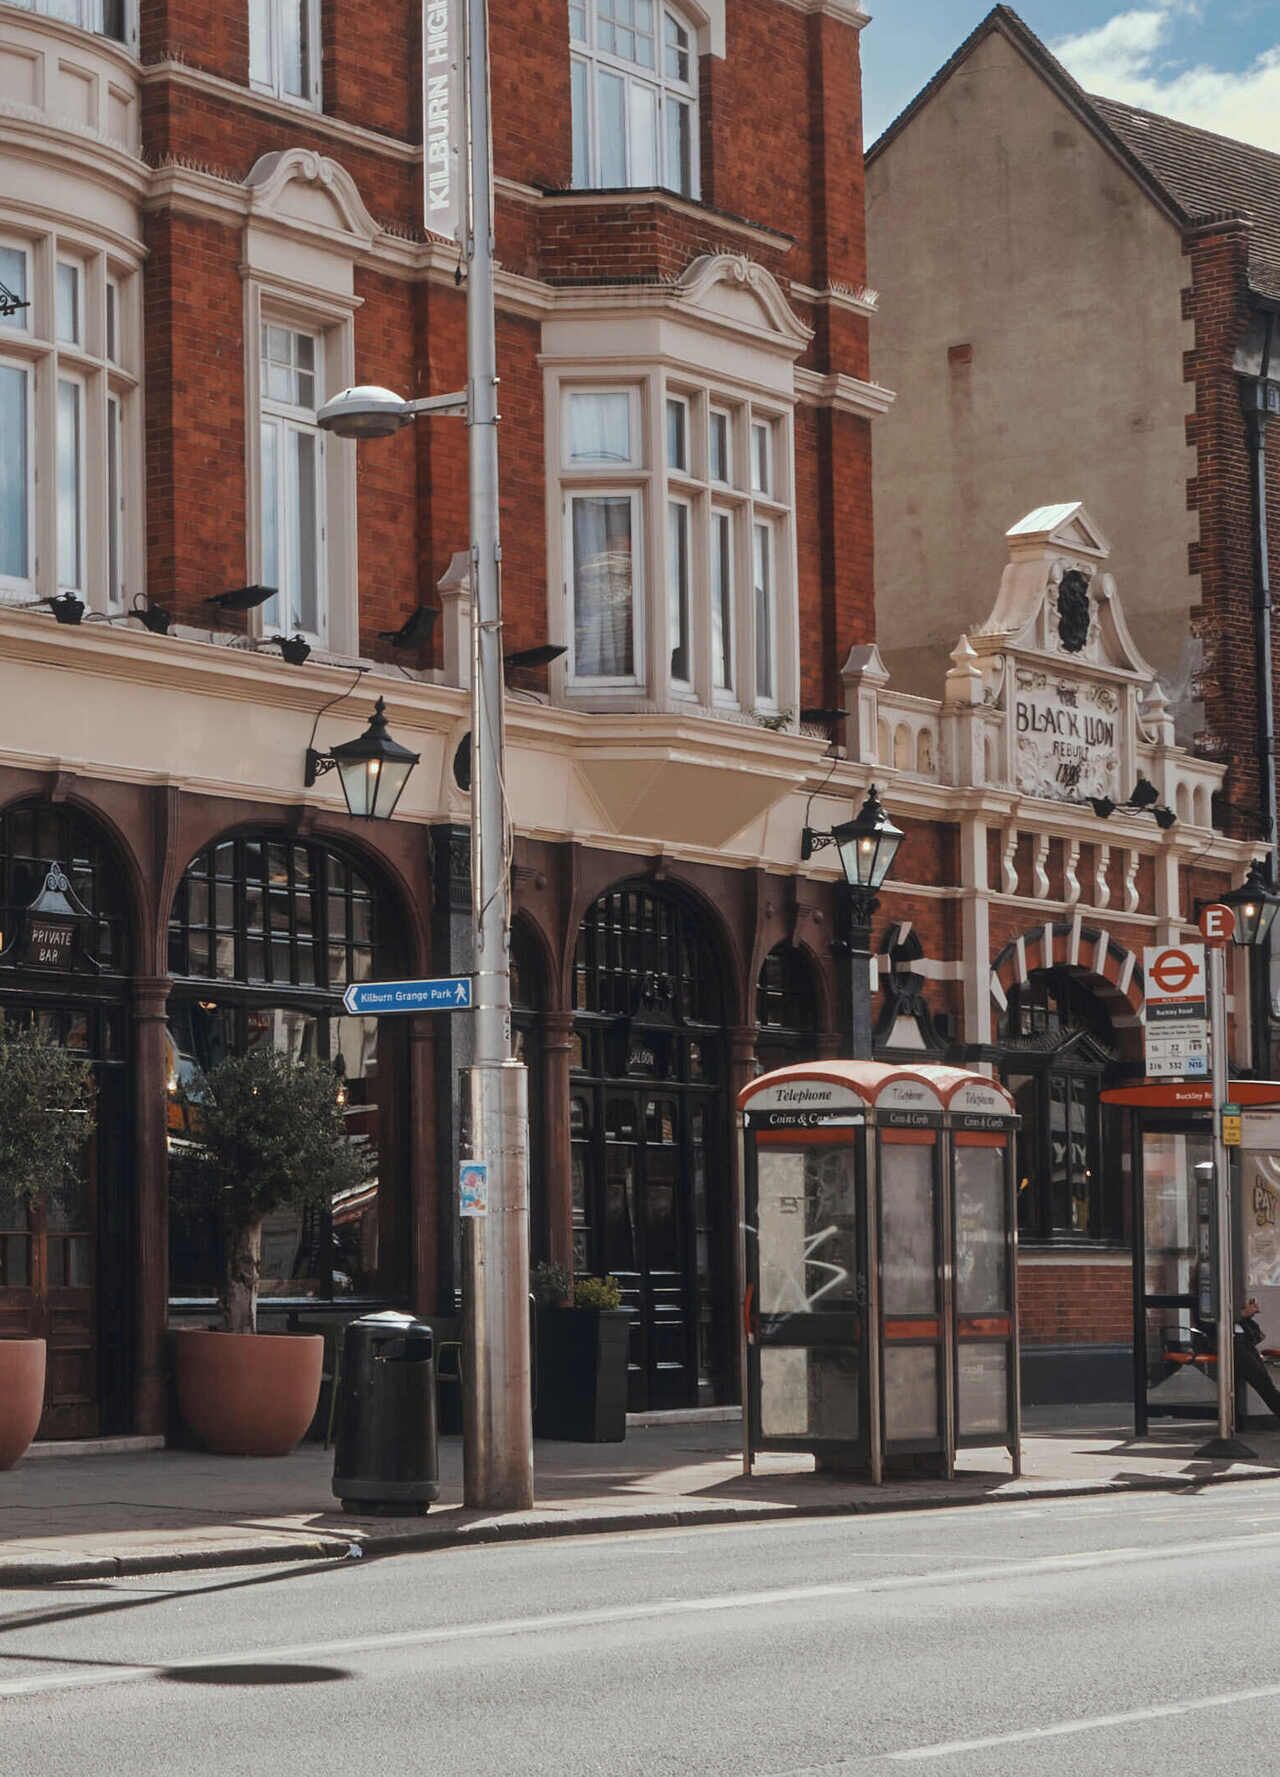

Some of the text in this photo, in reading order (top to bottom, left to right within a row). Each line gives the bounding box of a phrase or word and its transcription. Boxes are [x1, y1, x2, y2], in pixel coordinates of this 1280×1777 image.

[427, 74, 450, 211] KILBURN
[1016, 701, 1114, 747] BLACK LION
[1206, 910, 1225, 937] E
[32, 928, 72, 946] PRIVATE
[39, 948, 59, 962] BAR
[360, 988, 452, 1003] Kilburn Grange Park
[775, 1088, 832, 1104] Telephone
[1175, 1092, 1203, 1102] Buckley
[769, 1112, 796, 1124] Coins
[797, 1112, 808, 1126] &
